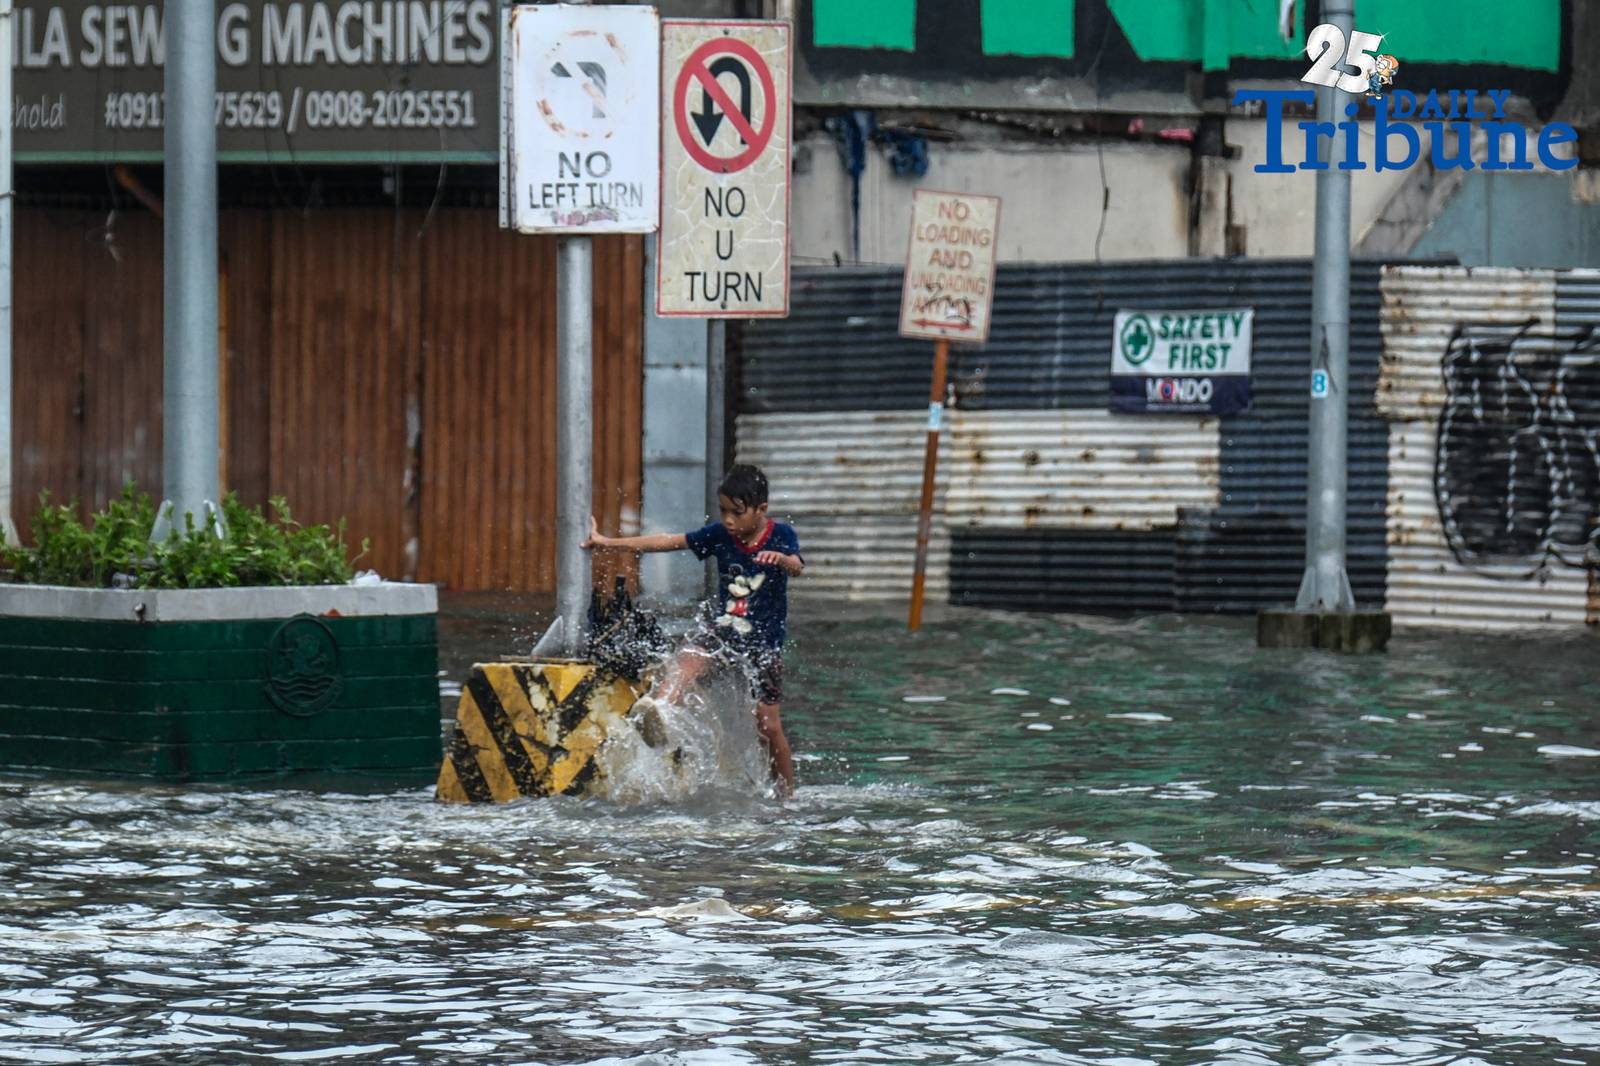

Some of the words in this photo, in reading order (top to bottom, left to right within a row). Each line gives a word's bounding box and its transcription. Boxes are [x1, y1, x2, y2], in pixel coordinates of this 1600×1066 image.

[80, 4, 249, 67] SEWG
[261, 0, 493, 65] MACHINES
[286, 86, 302, 134] /
[305, 90, 476, 128] 0908-2025551
[558, 151, 612, 179] NO
[529, 183, 579, 209] LEFT
[586, 182, 644, 209] TURN
[705, 186, 746, 218] NO
[938, 200, 971, 222] NO
[716, 229, 733, 261] U
[916, 223, 991, 248] LOADING
[928, 247, 974, 271] AND
[684, 271, 762, 302] TURN
[1157, 313, 1244, 340] SAFETY
[1168, 343, 1232, 370] FIRST
